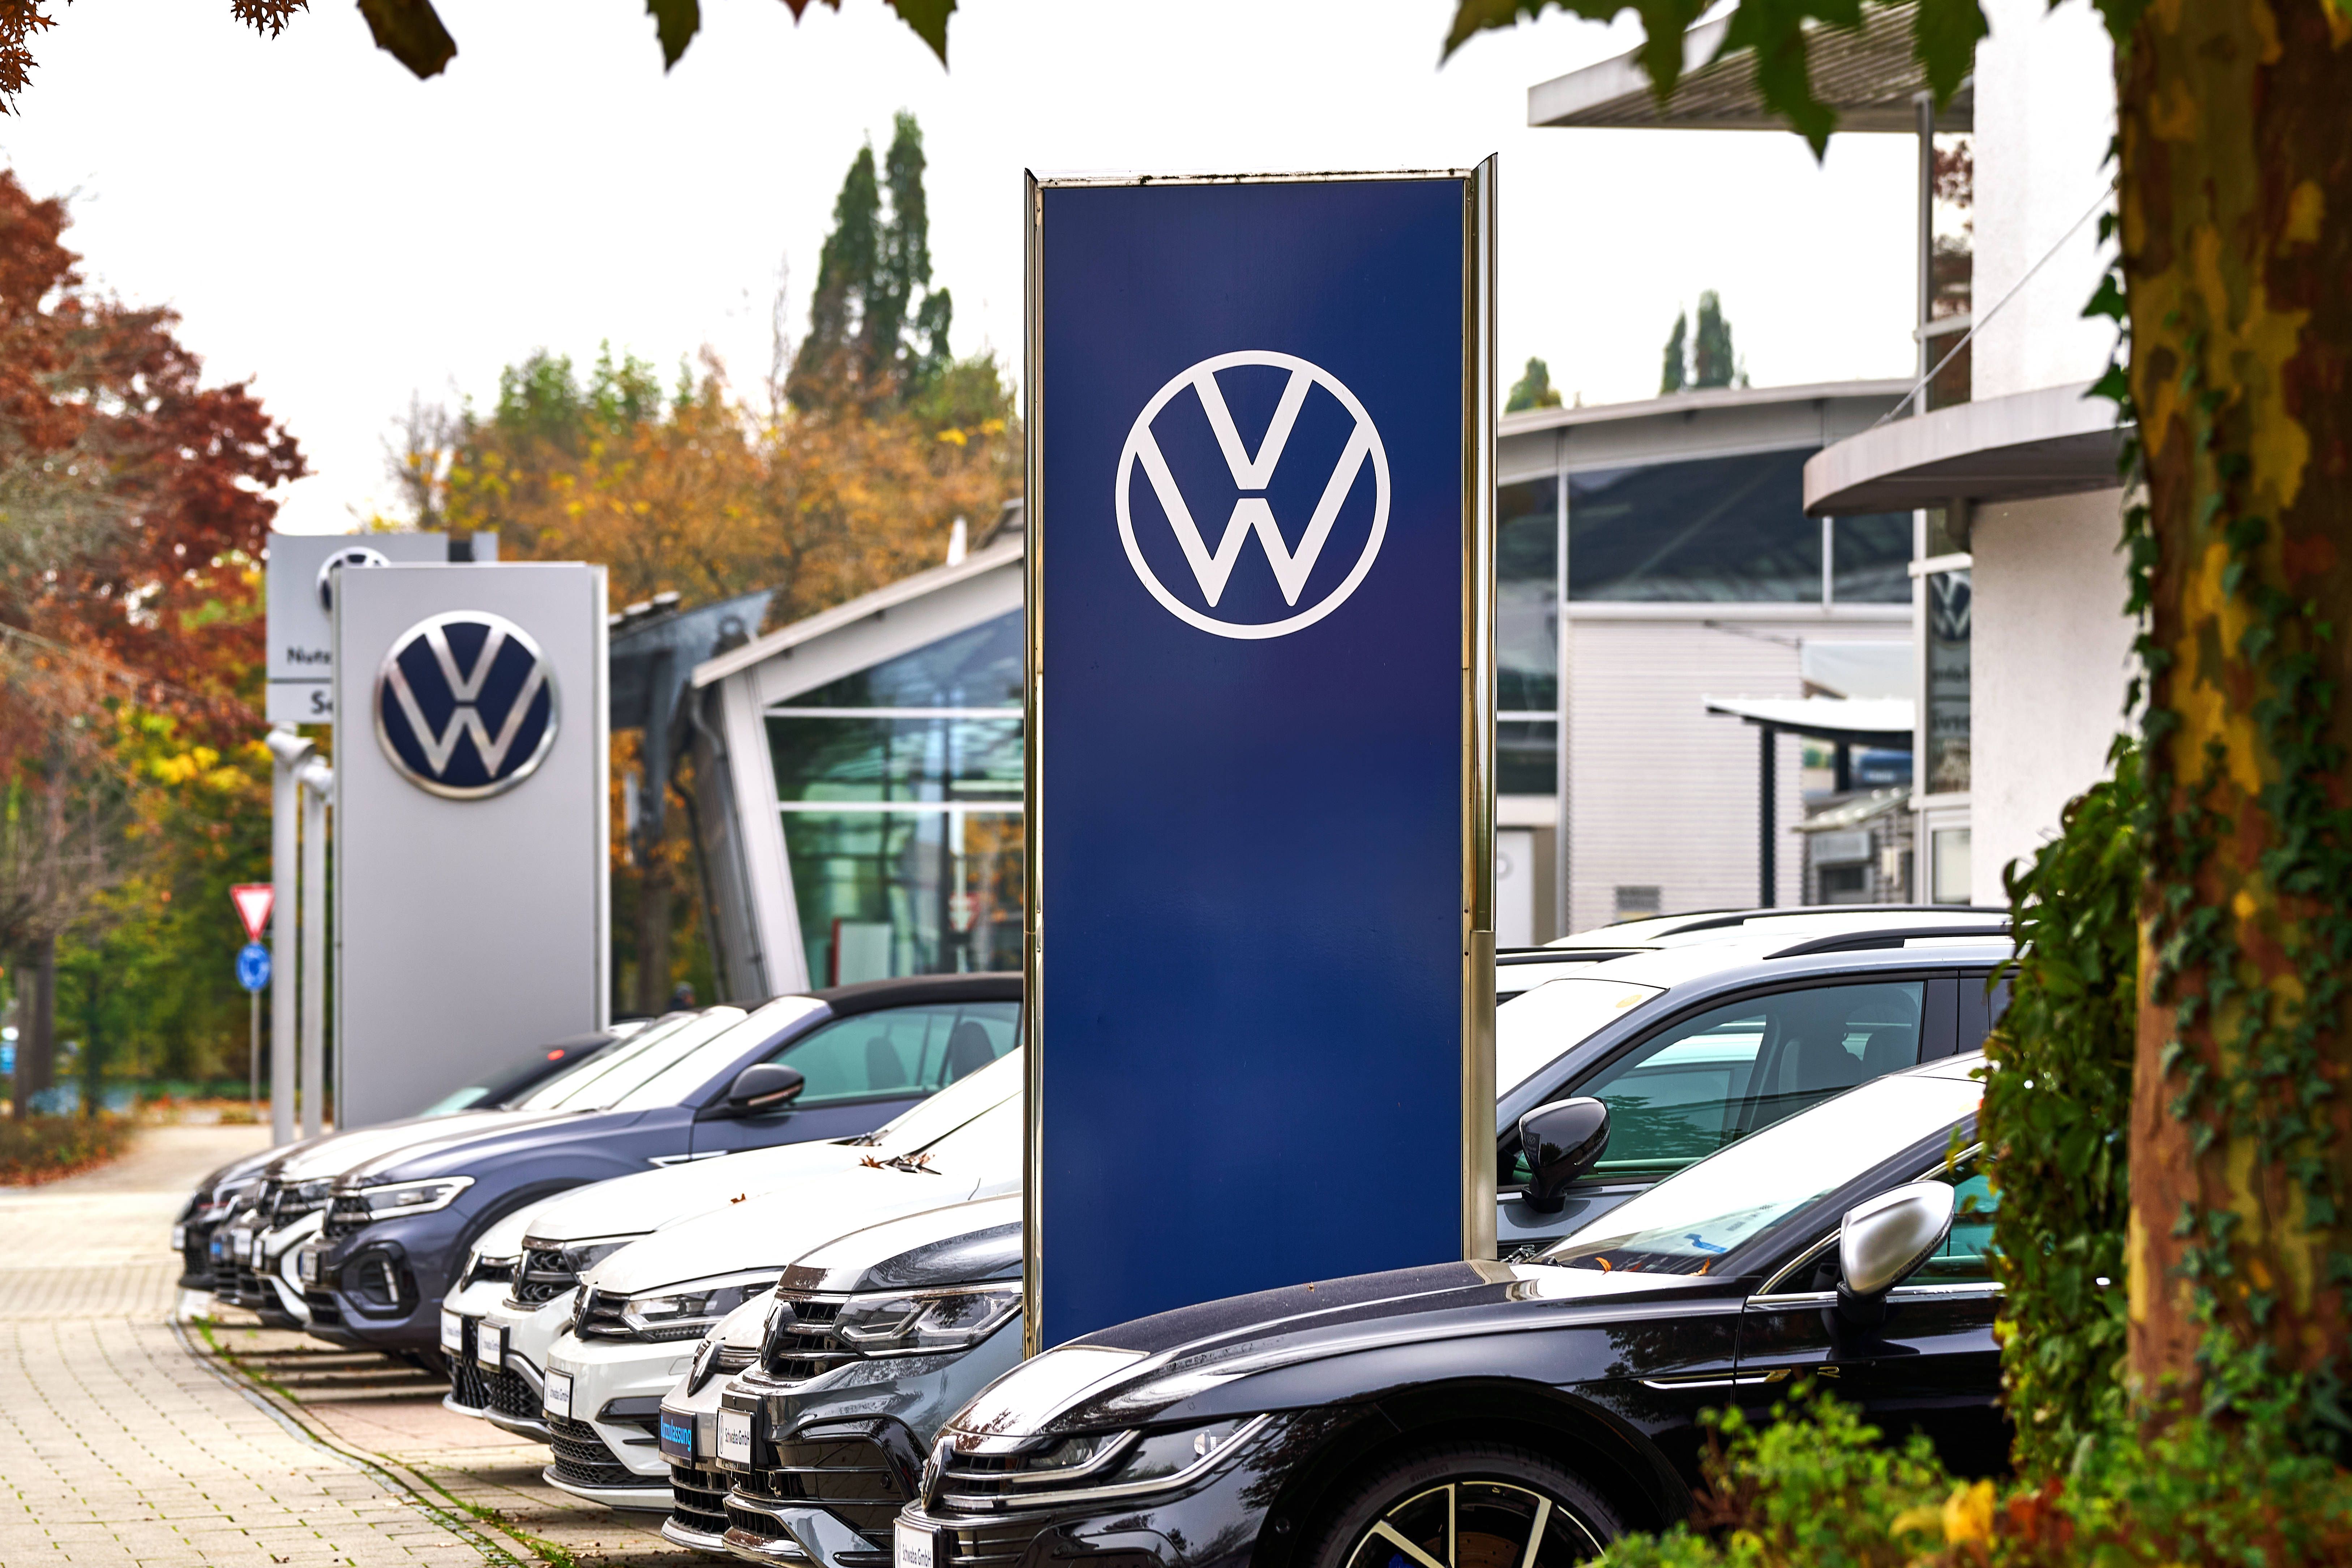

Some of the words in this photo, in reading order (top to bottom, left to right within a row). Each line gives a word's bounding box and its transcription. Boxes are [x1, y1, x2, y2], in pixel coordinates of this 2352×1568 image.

[1126, 364, 1377, 608] VW
[384, 619, 549, 779] VW
[725, 1428, 738, 1444] Schwaba
[738, 1430, 750, 1446] GmbH
[903, 1543, 917, 1564] Schwaba
[918, 1548, 931, 1568] GmbH
